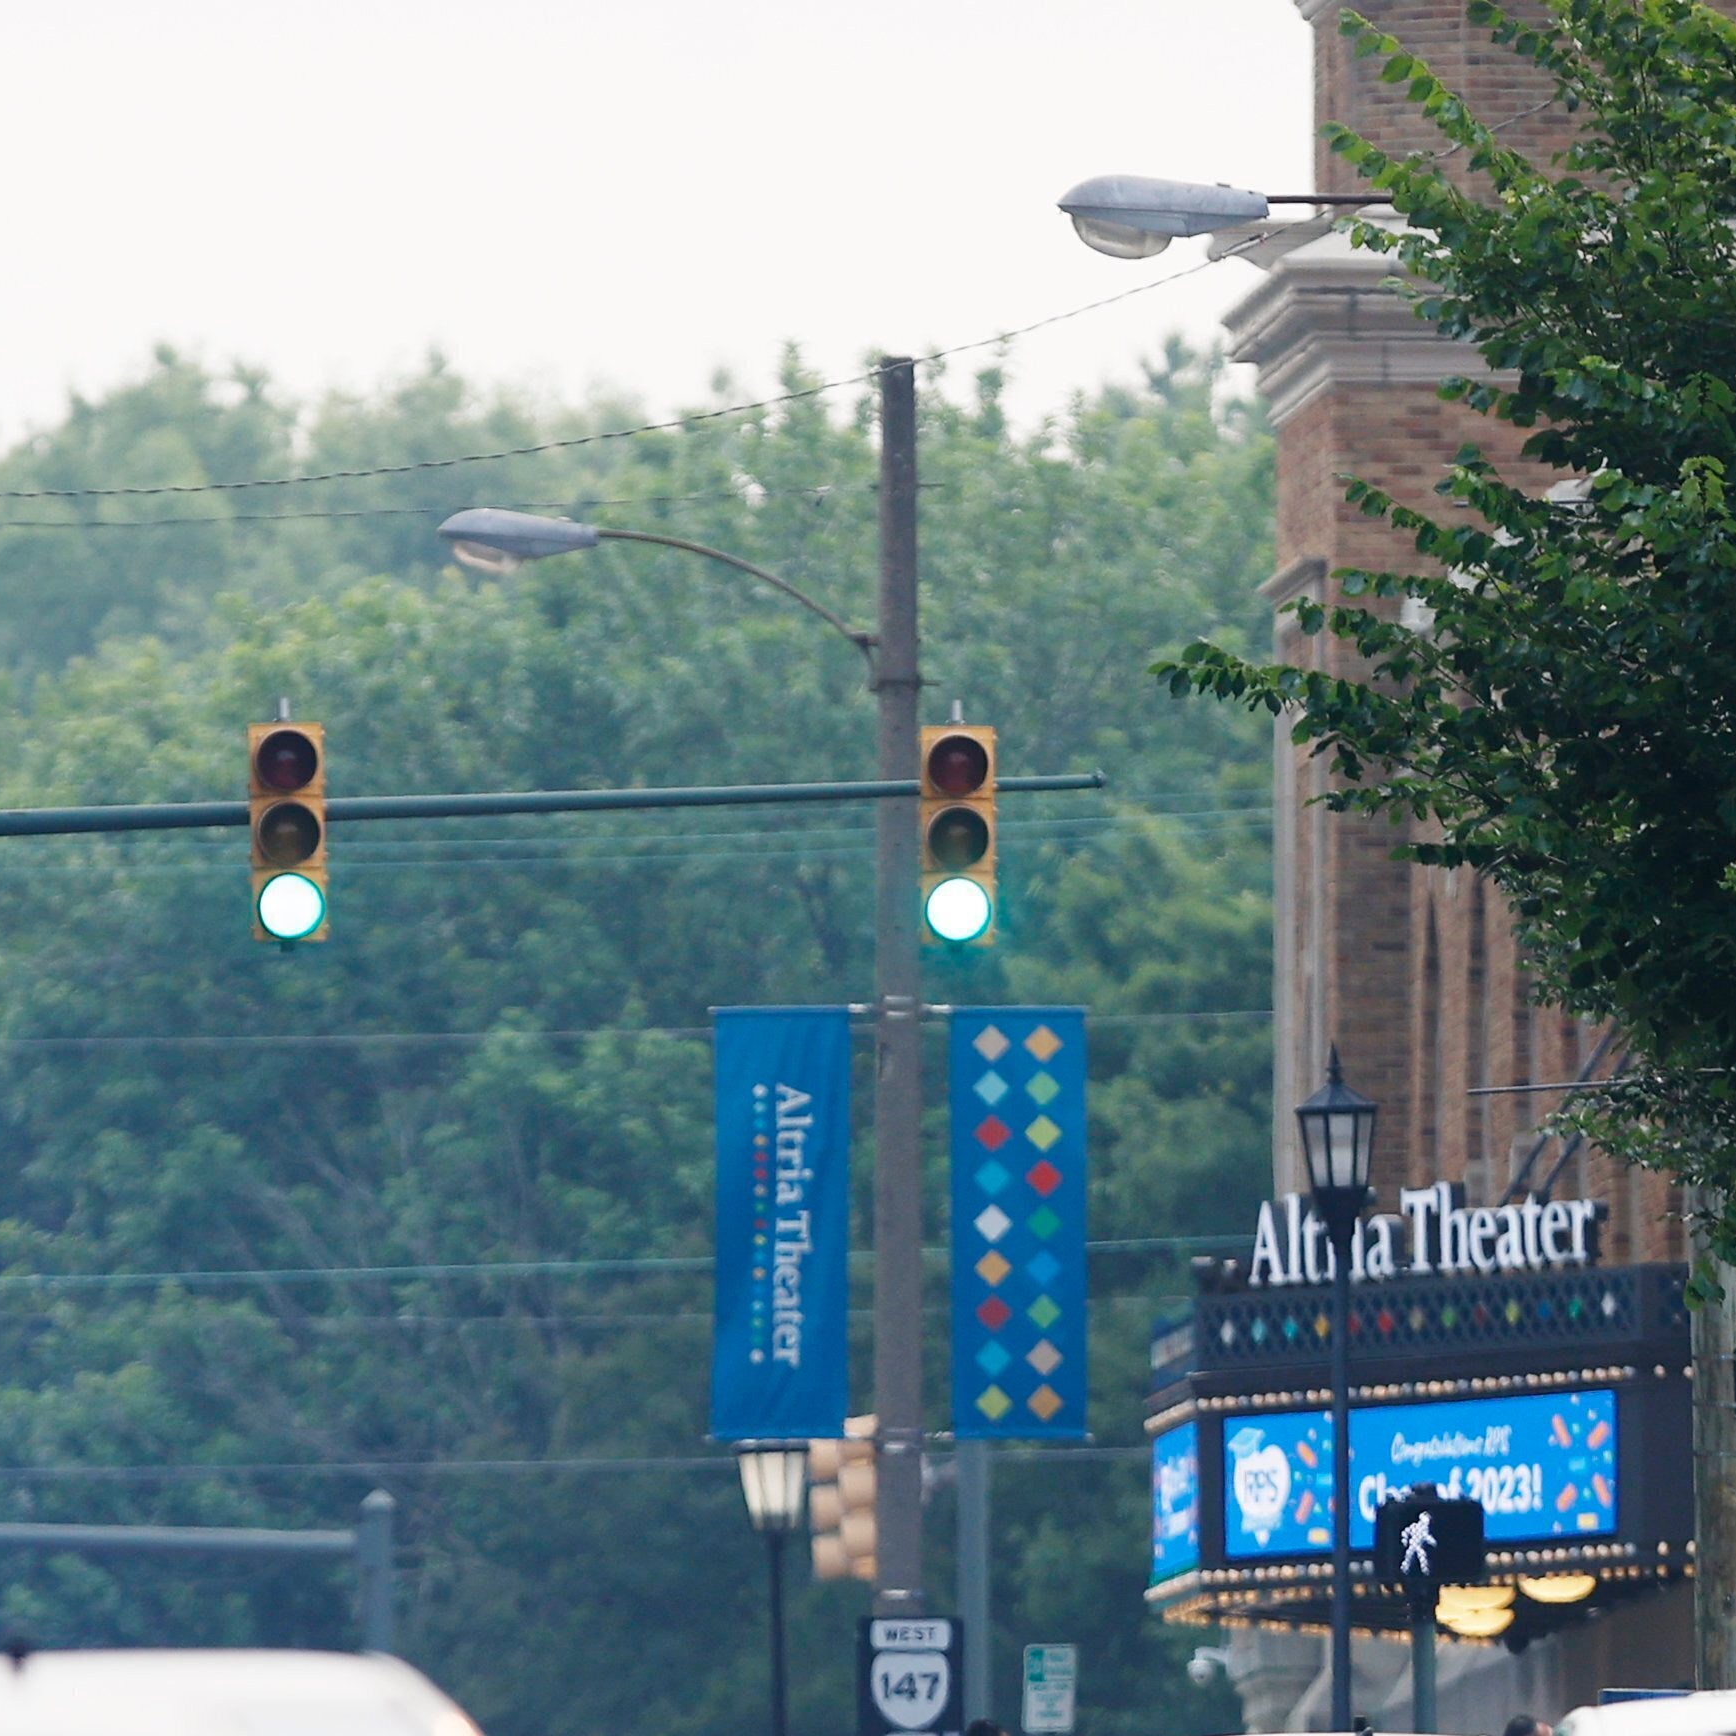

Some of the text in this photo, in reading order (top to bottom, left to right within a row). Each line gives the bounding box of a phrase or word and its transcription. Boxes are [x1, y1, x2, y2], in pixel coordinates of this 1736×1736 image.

[771, 1082, 814, 1368] Altria Theater
[1248, 1180, 1595, 1286] Altia Theater
[1466, 1464, 1542, 1515] 2023!
[885, 1627, 937, 1641] WEST
[881, 1672, 941, 1700] 147
